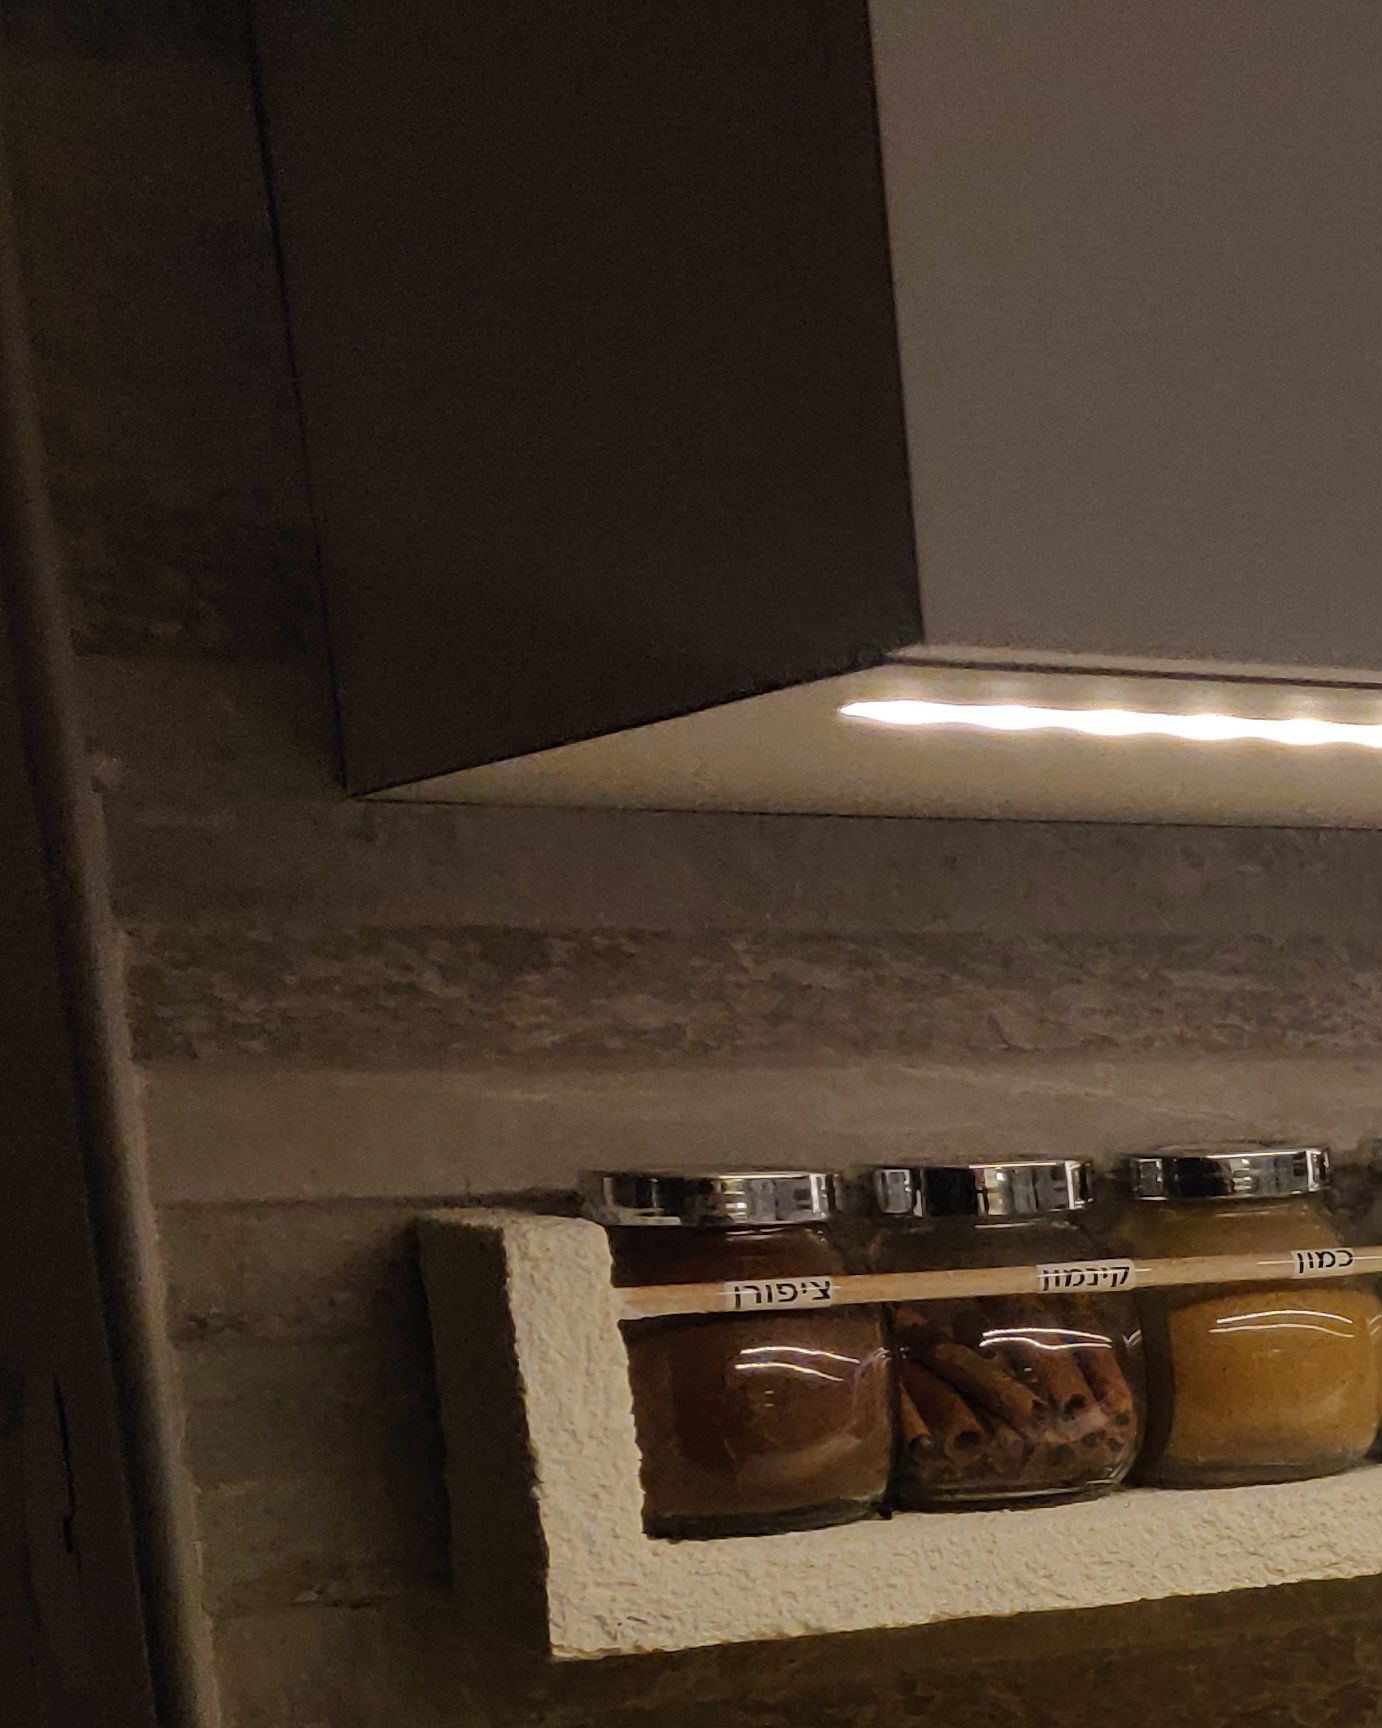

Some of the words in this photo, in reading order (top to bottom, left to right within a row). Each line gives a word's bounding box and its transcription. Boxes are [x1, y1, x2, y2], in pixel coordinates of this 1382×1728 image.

[1297, 1249, 1354, 1274] כמון
[1042, 1266, 1130, 1291] קינמון
[734, 1281, 831, 1308] ציפורן
